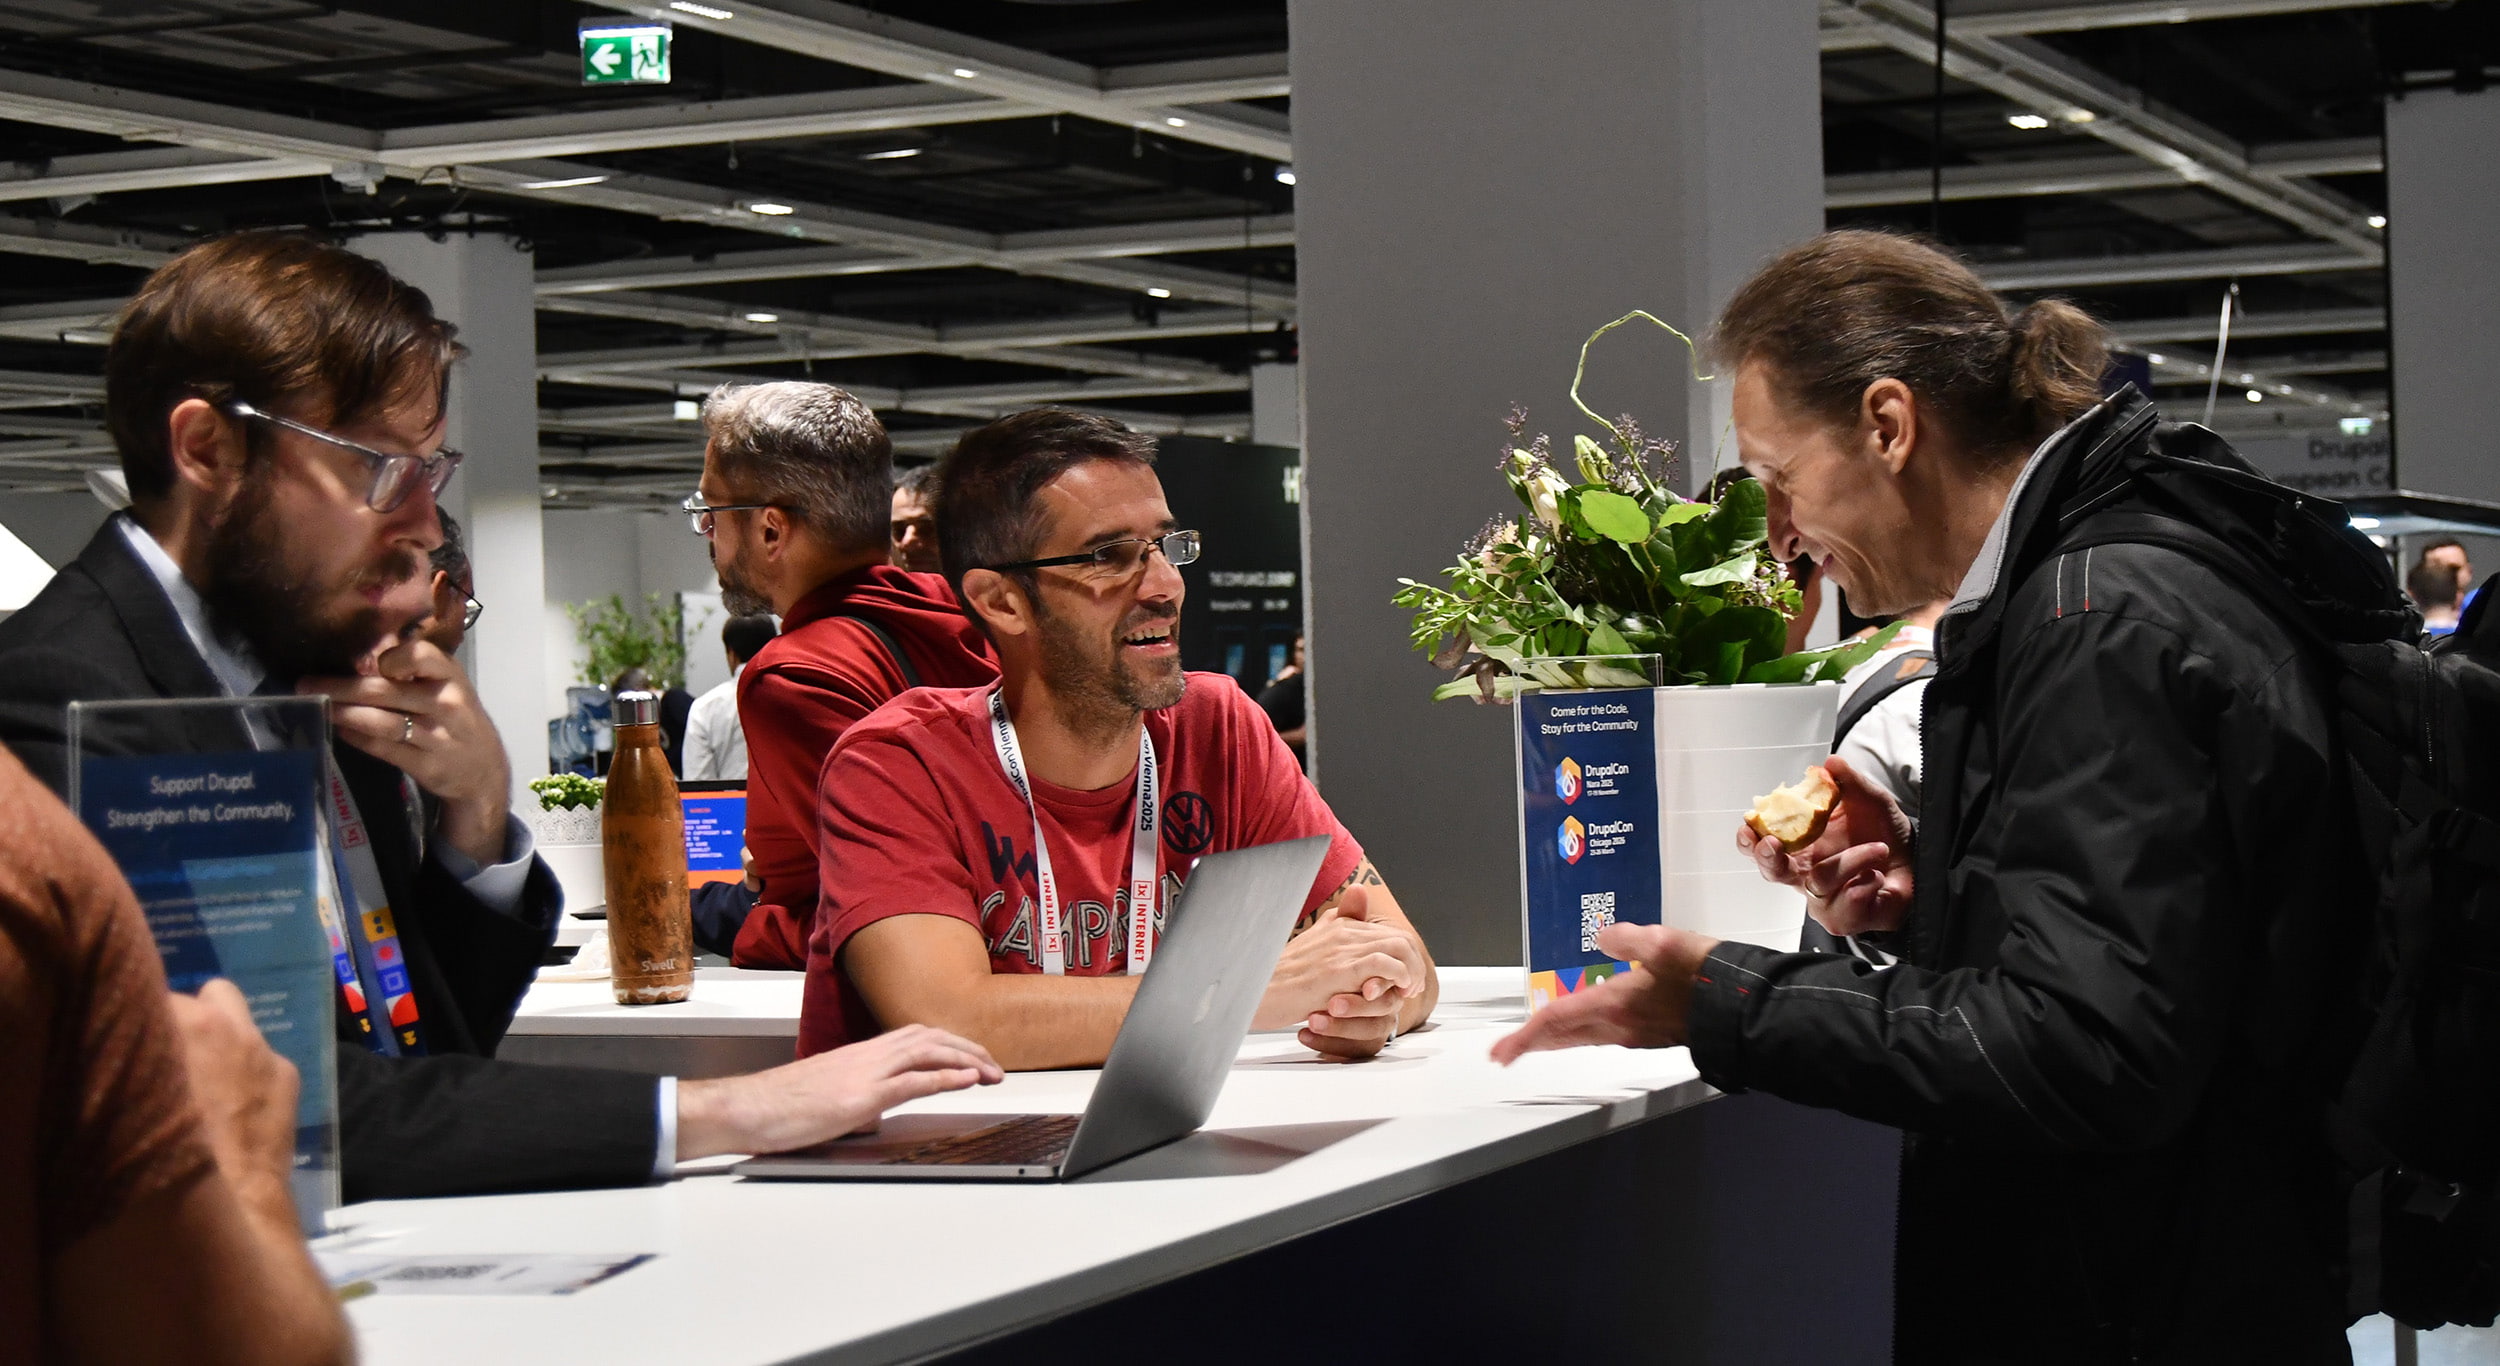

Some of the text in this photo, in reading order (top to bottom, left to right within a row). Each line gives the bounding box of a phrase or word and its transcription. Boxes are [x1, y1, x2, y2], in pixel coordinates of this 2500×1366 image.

[1551, 703, 1629, 718] Come for the Code,
[1541, 719, 1639, 736] Stay for the Community
[1585, 762, 1629, 779] DrupalCon
[150, 772, 256, 797] Support Drupal.
[1586, 780, 1600, 789] Nara
[107, 801, 296, 833] Strengthen the Community.
[1588, 820, 1634, 838] DrupalCon
[1589, 838, 1611, 849] Chicago
[1042, 871, 1055, 930] INTERNET
[1134, 903, 1148, 963] INTERNET
